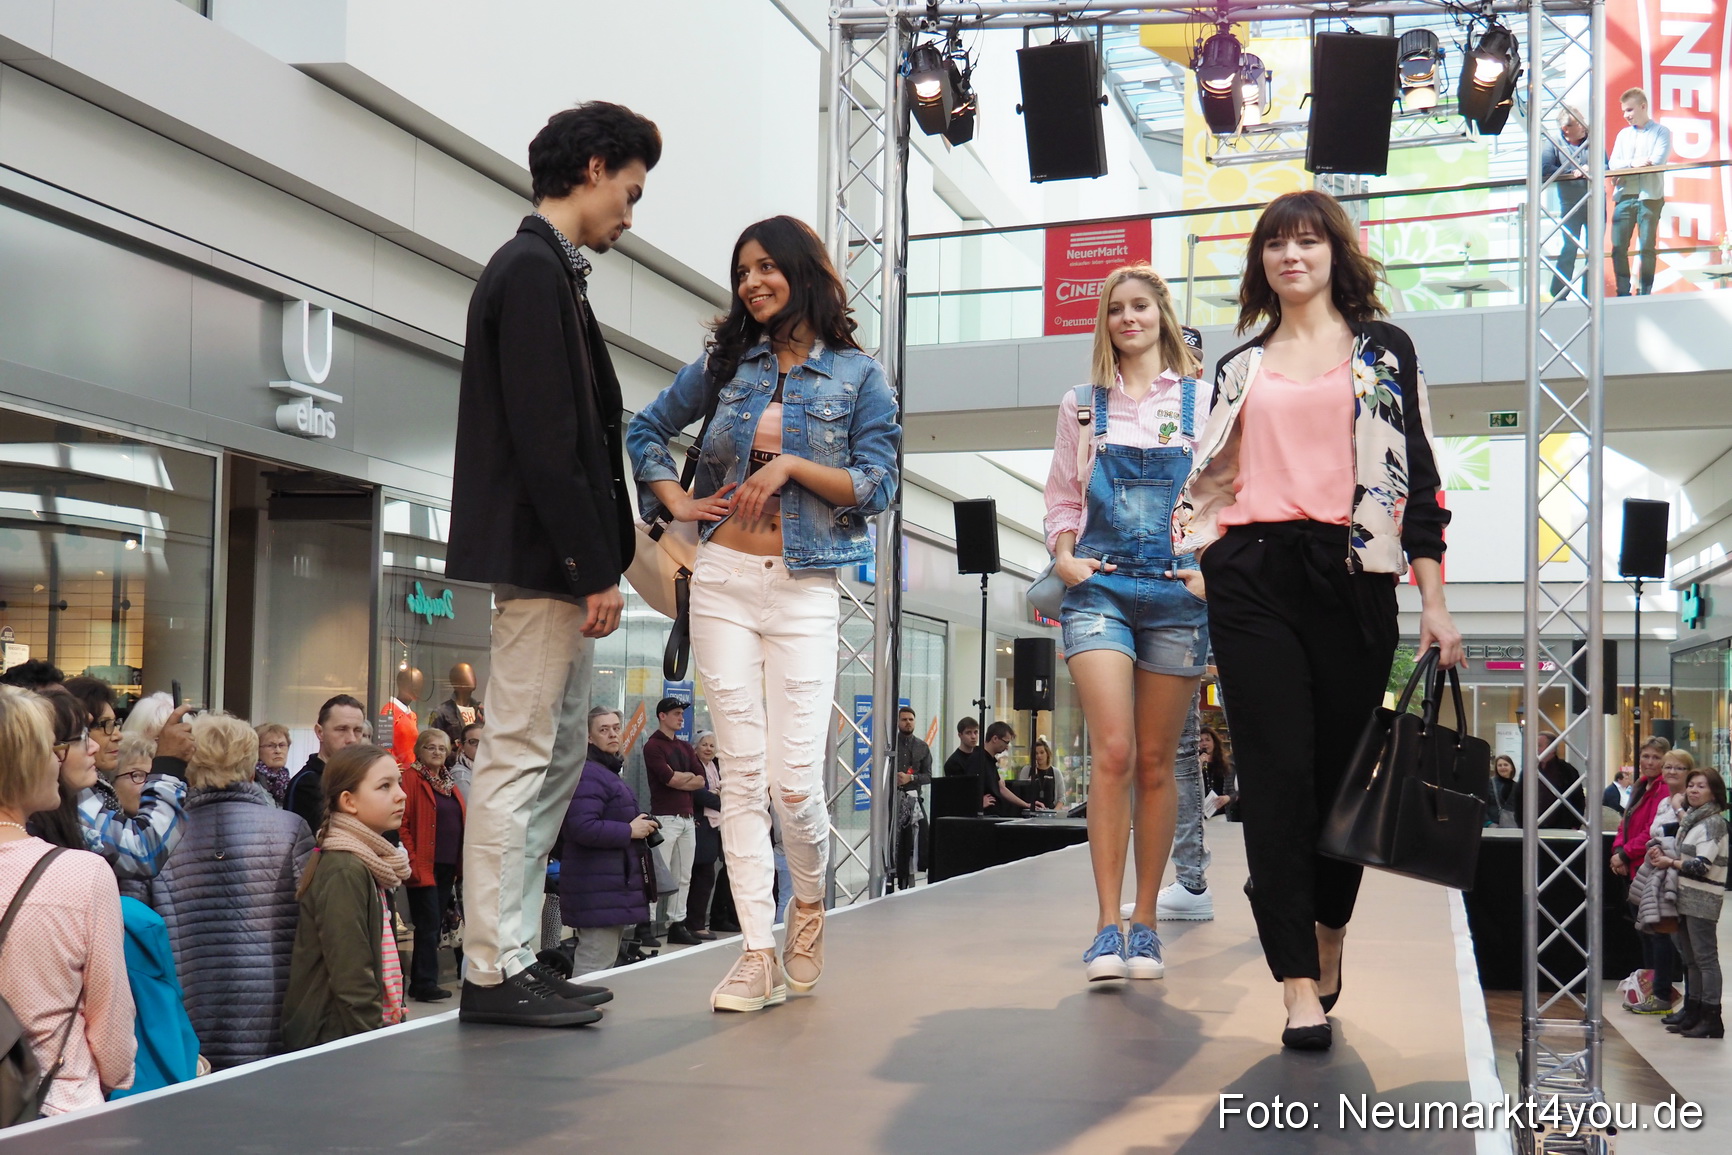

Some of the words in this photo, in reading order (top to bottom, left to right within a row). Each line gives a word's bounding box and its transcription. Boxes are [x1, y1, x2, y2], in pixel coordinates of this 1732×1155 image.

[1066, 245, 1129, 260] NeuerMarkt
[282, 299, 334, 384] U
[275, 396, 337, 440] eins
